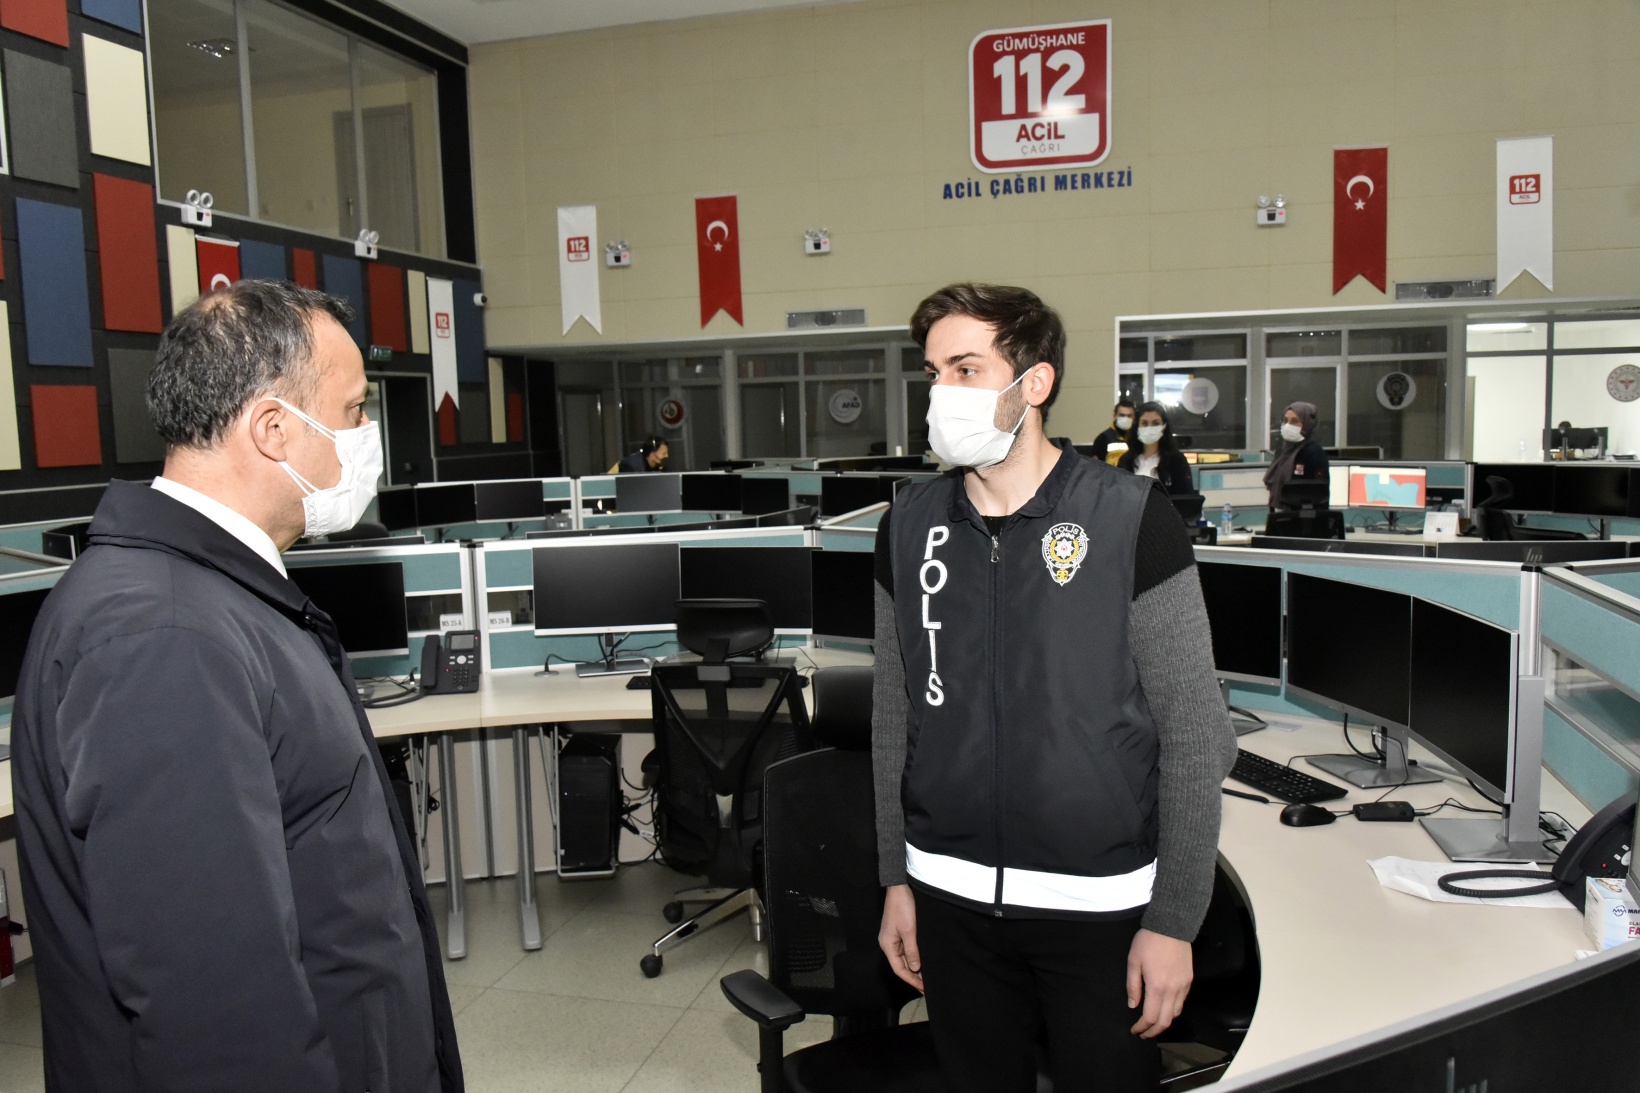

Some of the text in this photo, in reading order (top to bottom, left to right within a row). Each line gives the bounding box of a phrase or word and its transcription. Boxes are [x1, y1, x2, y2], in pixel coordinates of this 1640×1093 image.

[993, 32, 1086, 52] GÜMÜŞHANE
[993, 49, 1086, 115] 112
[1021, 142, 1060, 156] ÇAĞRI
[943, 166, 1133, 200] ACİL ÇAĞRI MERKEZİ
[1513, 178, 1536, 192] 112
[570, 239, 587, 252] 112
